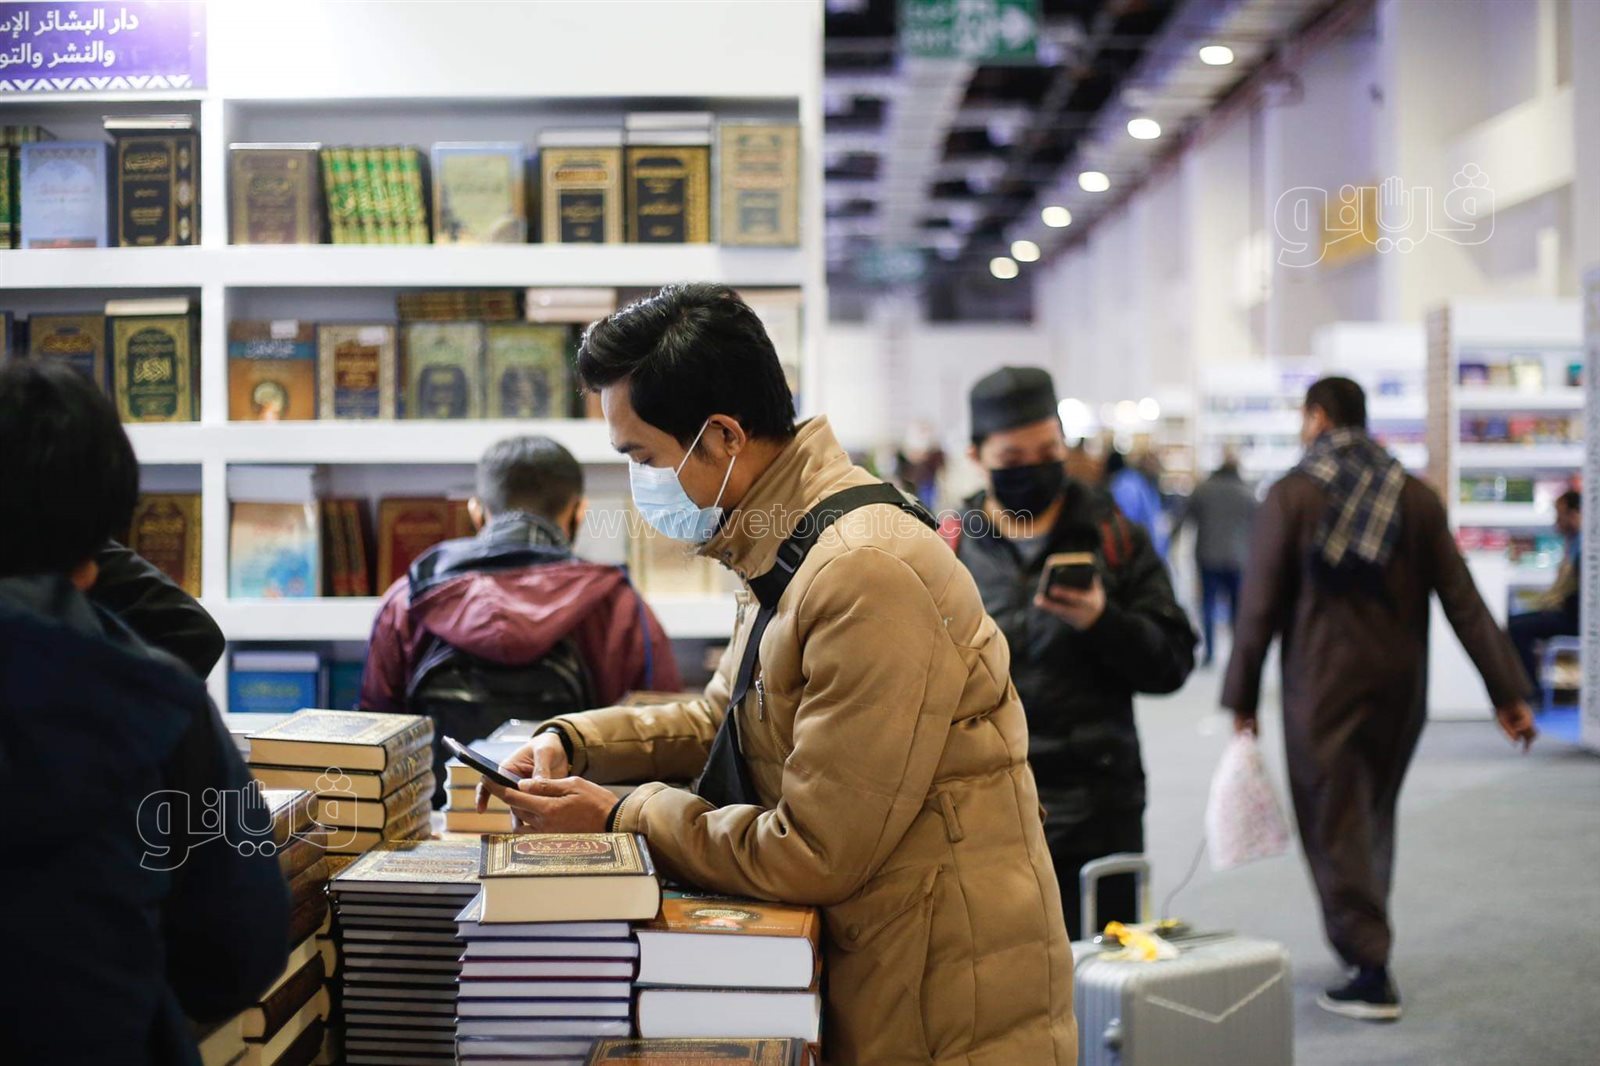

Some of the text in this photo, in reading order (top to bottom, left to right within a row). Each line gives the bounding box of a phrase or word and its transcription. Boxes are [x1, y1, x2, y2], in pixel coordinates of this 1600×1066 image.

[34, 8, 105, 36] البشائر
[108, 8, 139, 35] دار
[47, 40, 116, 68] والنشر
